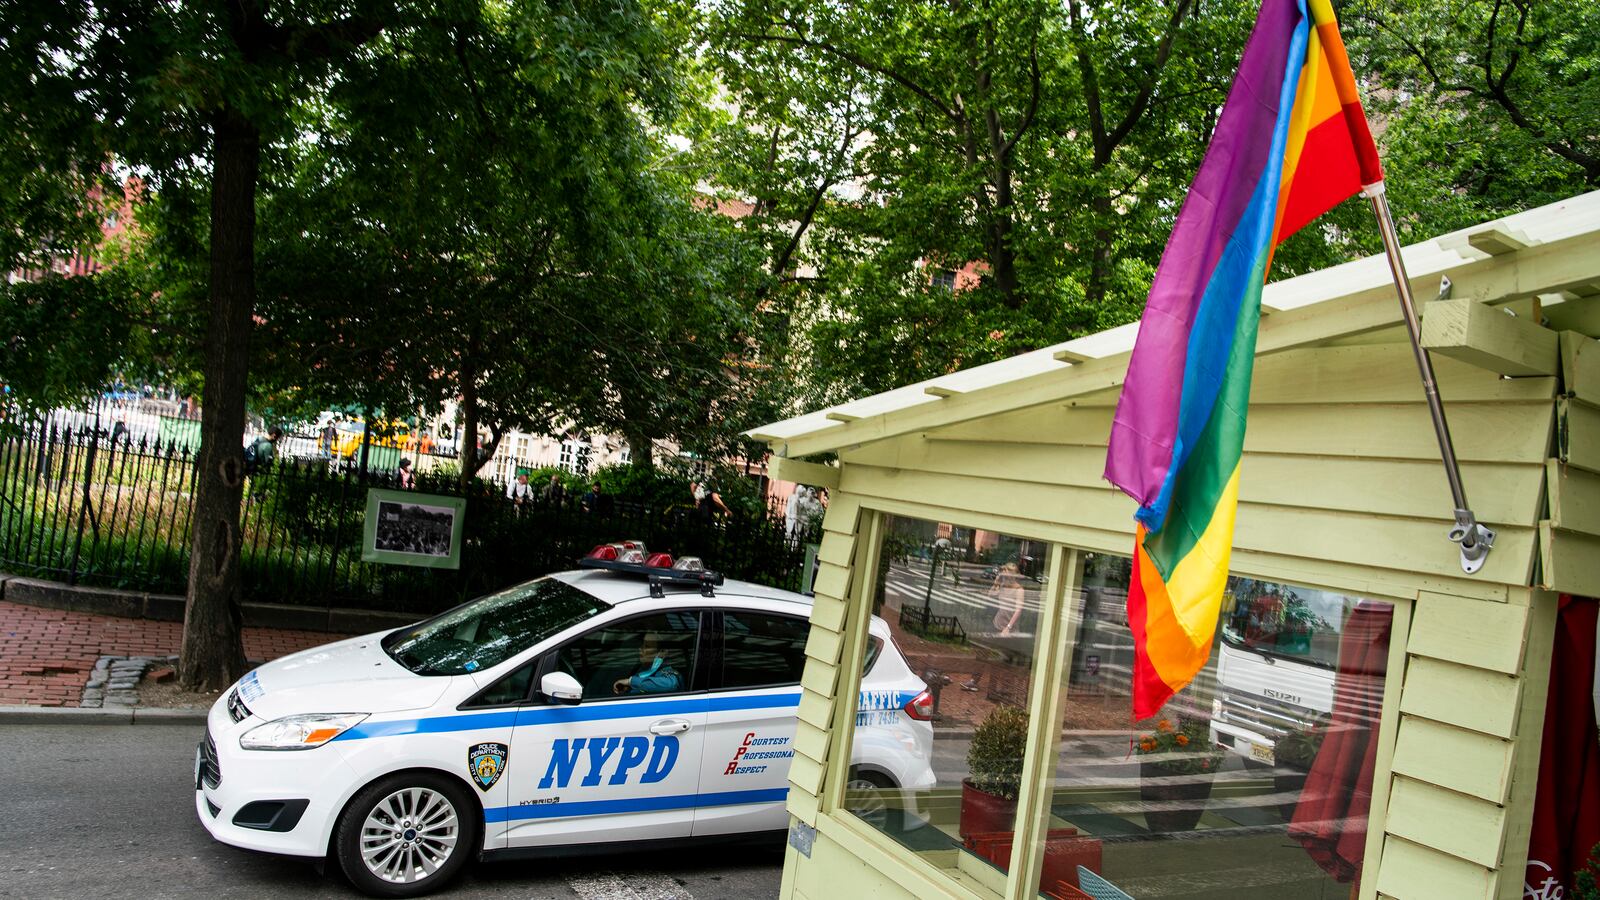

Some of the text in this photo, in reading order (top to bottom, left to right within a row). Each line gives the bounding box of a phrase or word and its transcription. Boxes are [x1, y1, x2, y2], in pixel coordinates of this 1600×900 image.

[857, 690, 901, 711] AFFIC
[1263, 688, 1301, 703] ISUZU
[743, 733, 789, 746] COURTESY
[470, 748, 506, 758] DEPARTMENT
[537, 735, 680, 789] NYPD
[724, 762, 767, 775] RESPECT
[519, 798, 553, 806] HYBRID
